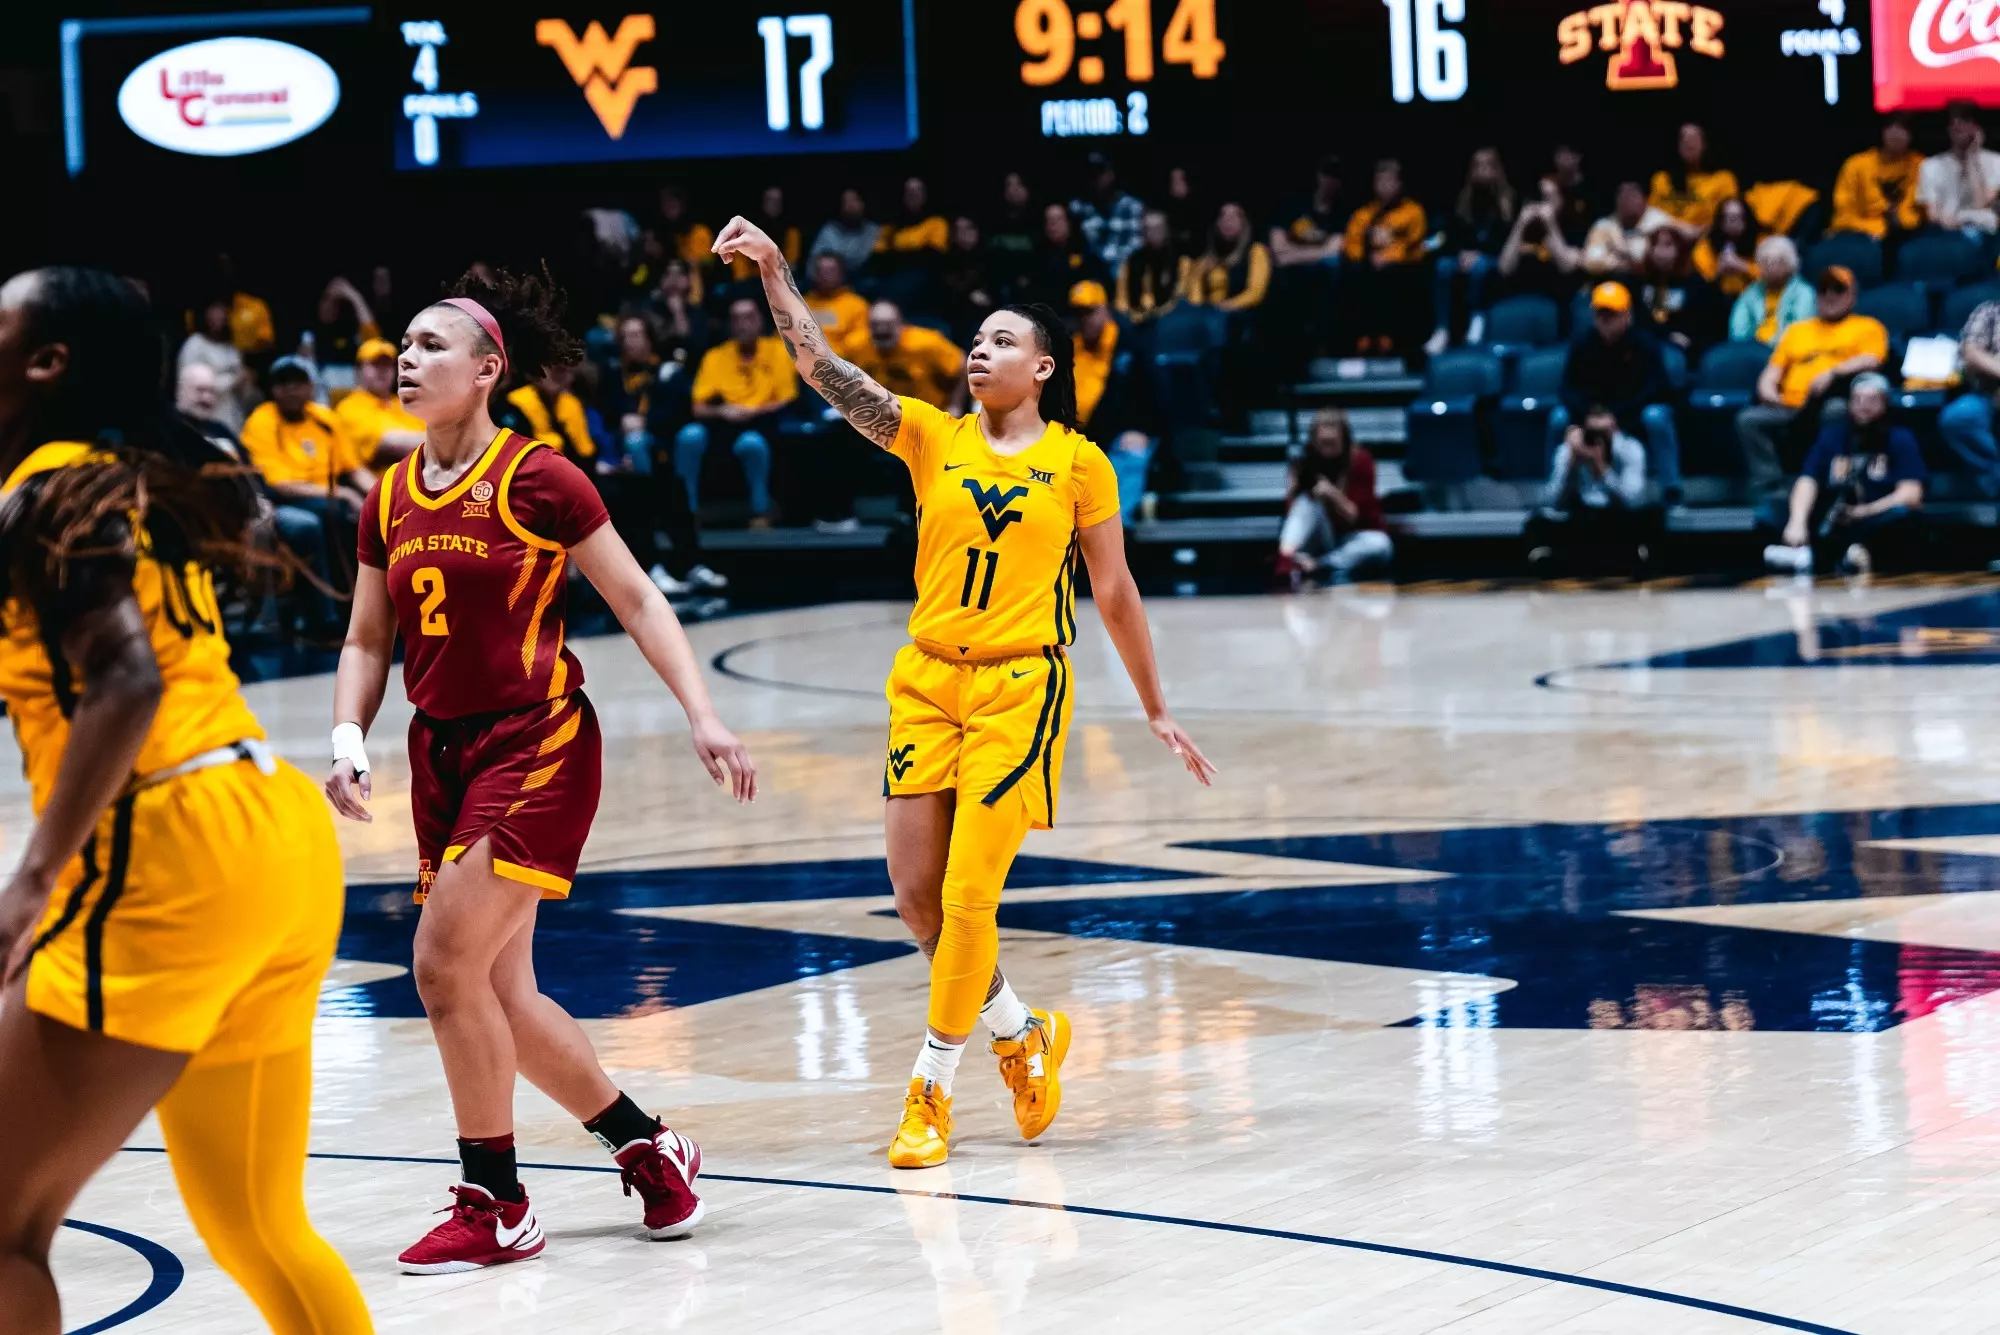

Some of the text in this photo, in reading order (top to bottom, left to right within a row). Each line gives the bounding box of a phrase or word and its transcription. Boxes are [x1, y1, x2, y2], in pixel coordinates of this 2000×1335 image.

[1014, 0, 1226, 86] 9:14
[1383, 0, 1468, 103] 16
[1557, 0, 1726, 65] STATE
[757, 14, 833, 131] 17
[1126, 90, 1149, 135] 2
[474, 485, 491, 497] 50
[427, 534, 489, 559] STATE
[960, 547, 999, 611] 11
[411, 566, 450, 636] 2
